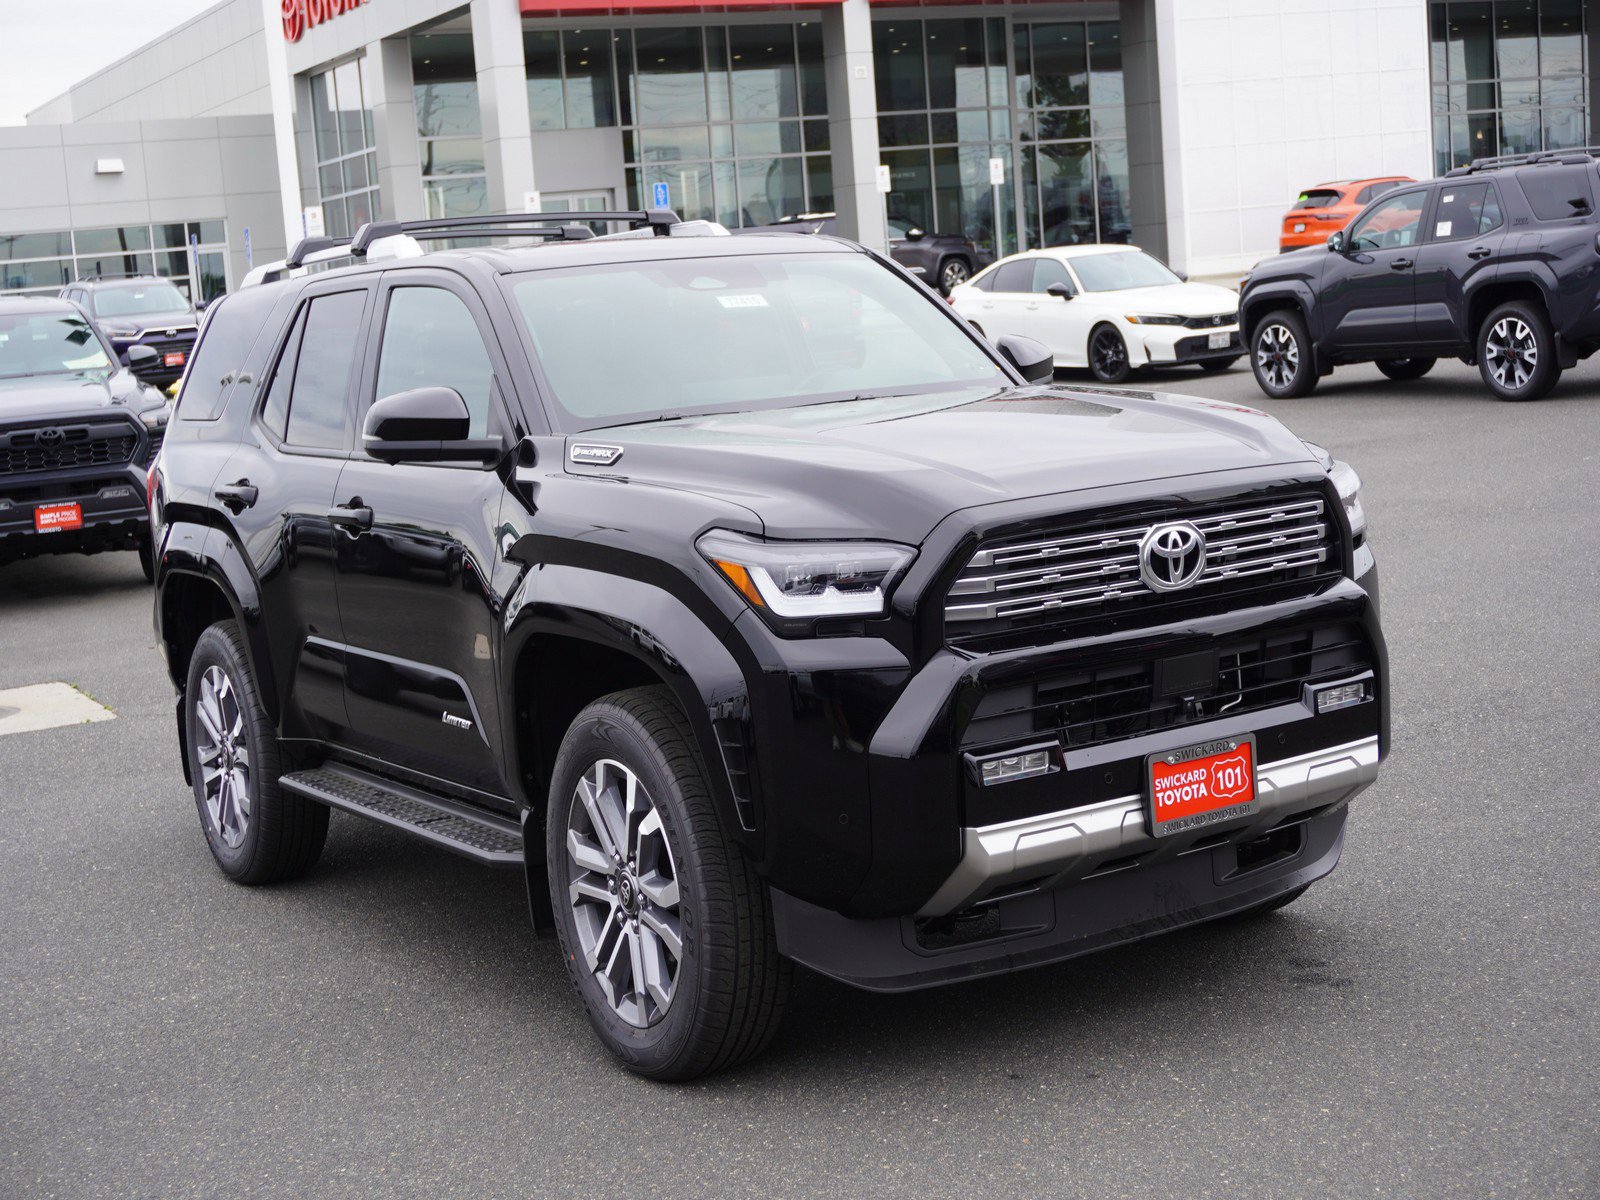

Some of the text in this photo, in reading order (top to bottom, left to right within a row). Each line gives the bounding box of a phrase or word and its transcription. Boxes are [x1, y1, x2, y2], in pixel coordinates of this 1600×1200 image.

[300, 0, 367, 29] TOYO
[38, 526, 62, 534] MODESTO
[1174, 741, 1230, 762] SWICKARD
[1155, 768, 1207, 791] SWICKARD
[1216, 765, 1242, 790] 101
[1156, 782, 1208, 807] TOYOTA
[1163, 804, 1251, 834] SWICKARD TOYOTA 101
